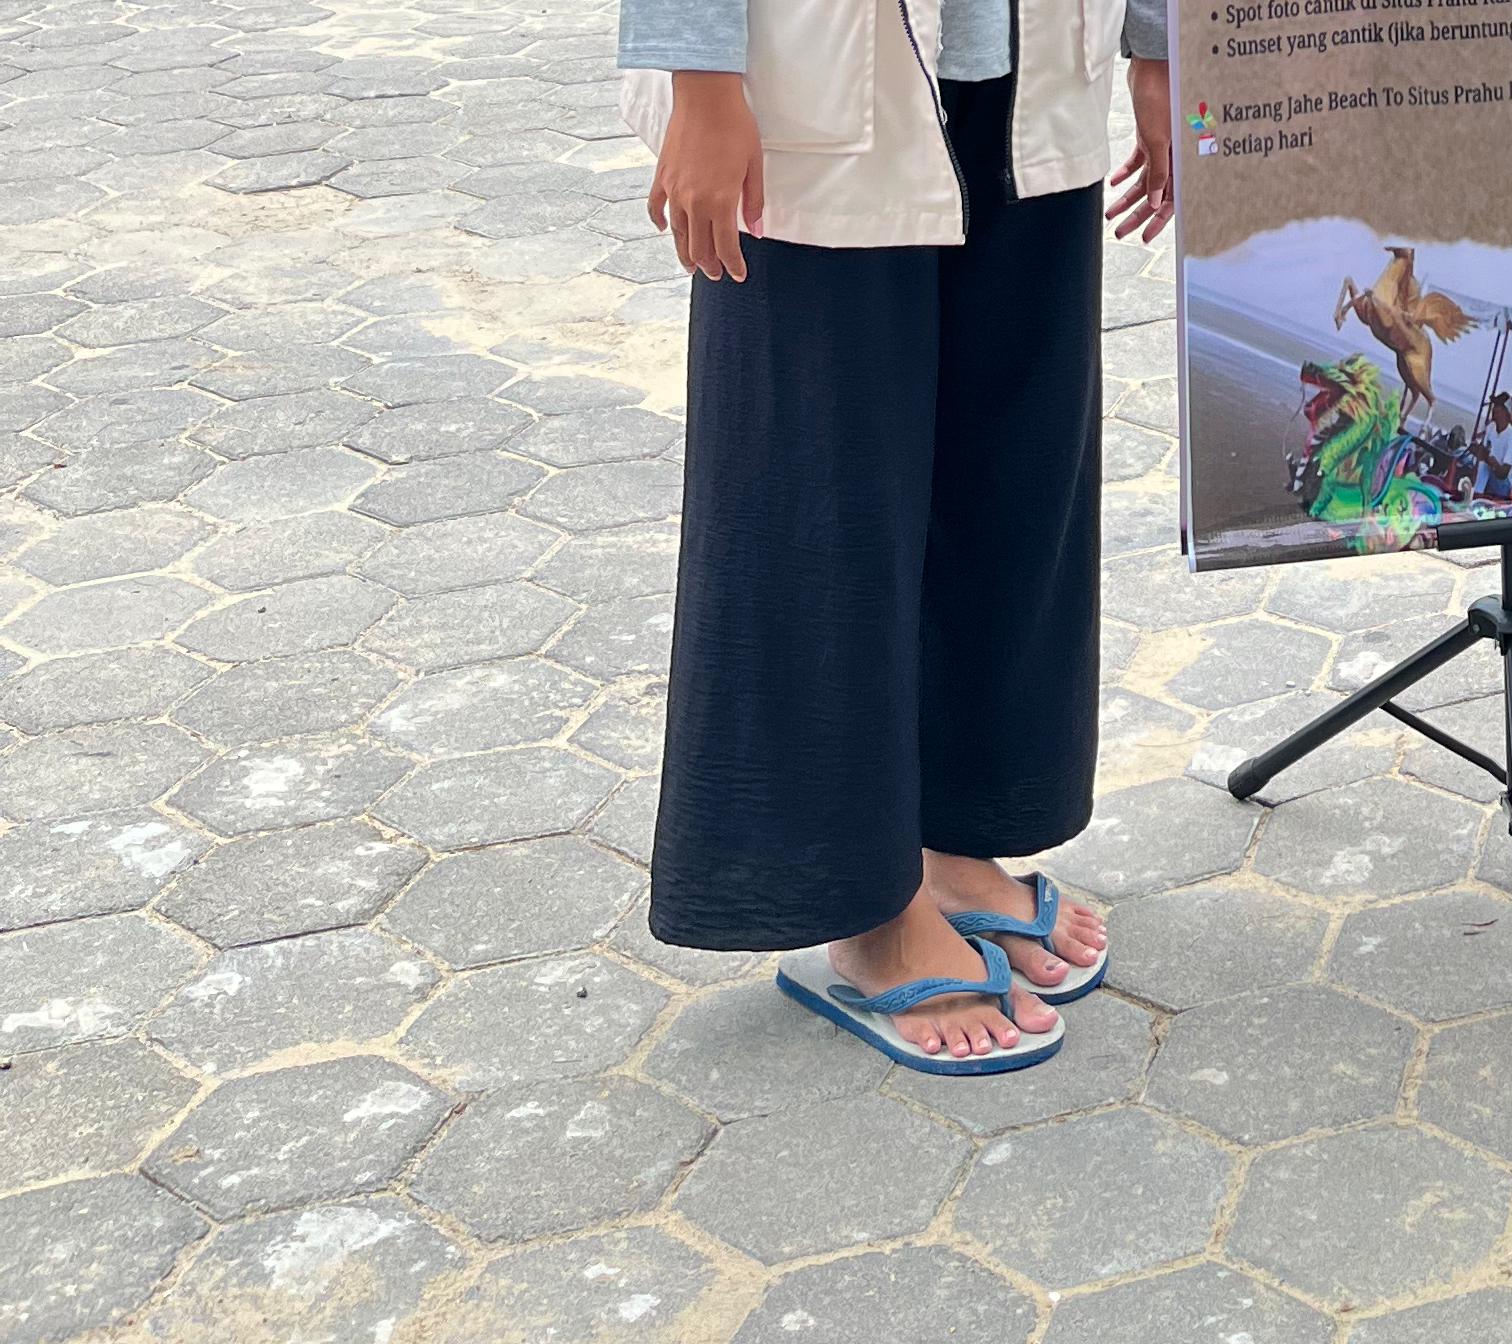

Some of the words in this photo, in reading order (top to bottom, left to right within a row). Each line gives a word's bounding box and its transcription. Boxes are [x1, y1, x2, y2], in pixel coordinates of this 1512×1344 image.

[1226, 2, 1263, 28] Spot
[1227, 35, 1283, 57] Sunset
[1287, 32, 1328, 56] yang
[1332, 22, 1384, 46] cantik
[1388, 20, 1425, 47] (jika
[1222, 102, 1283, 124] Karang
[1287, 93, 1323, 121] Jahe
[1328, 87, 1378, 111] Beach
[1382, 87, 1404, 107] To
[1408, 85, 1449, 106] Situs
[1453, 82, 1503, 105] Prahu
[1222, 134, 1274, 158] Setiap
[1278, 126, 1313, 151] hari
